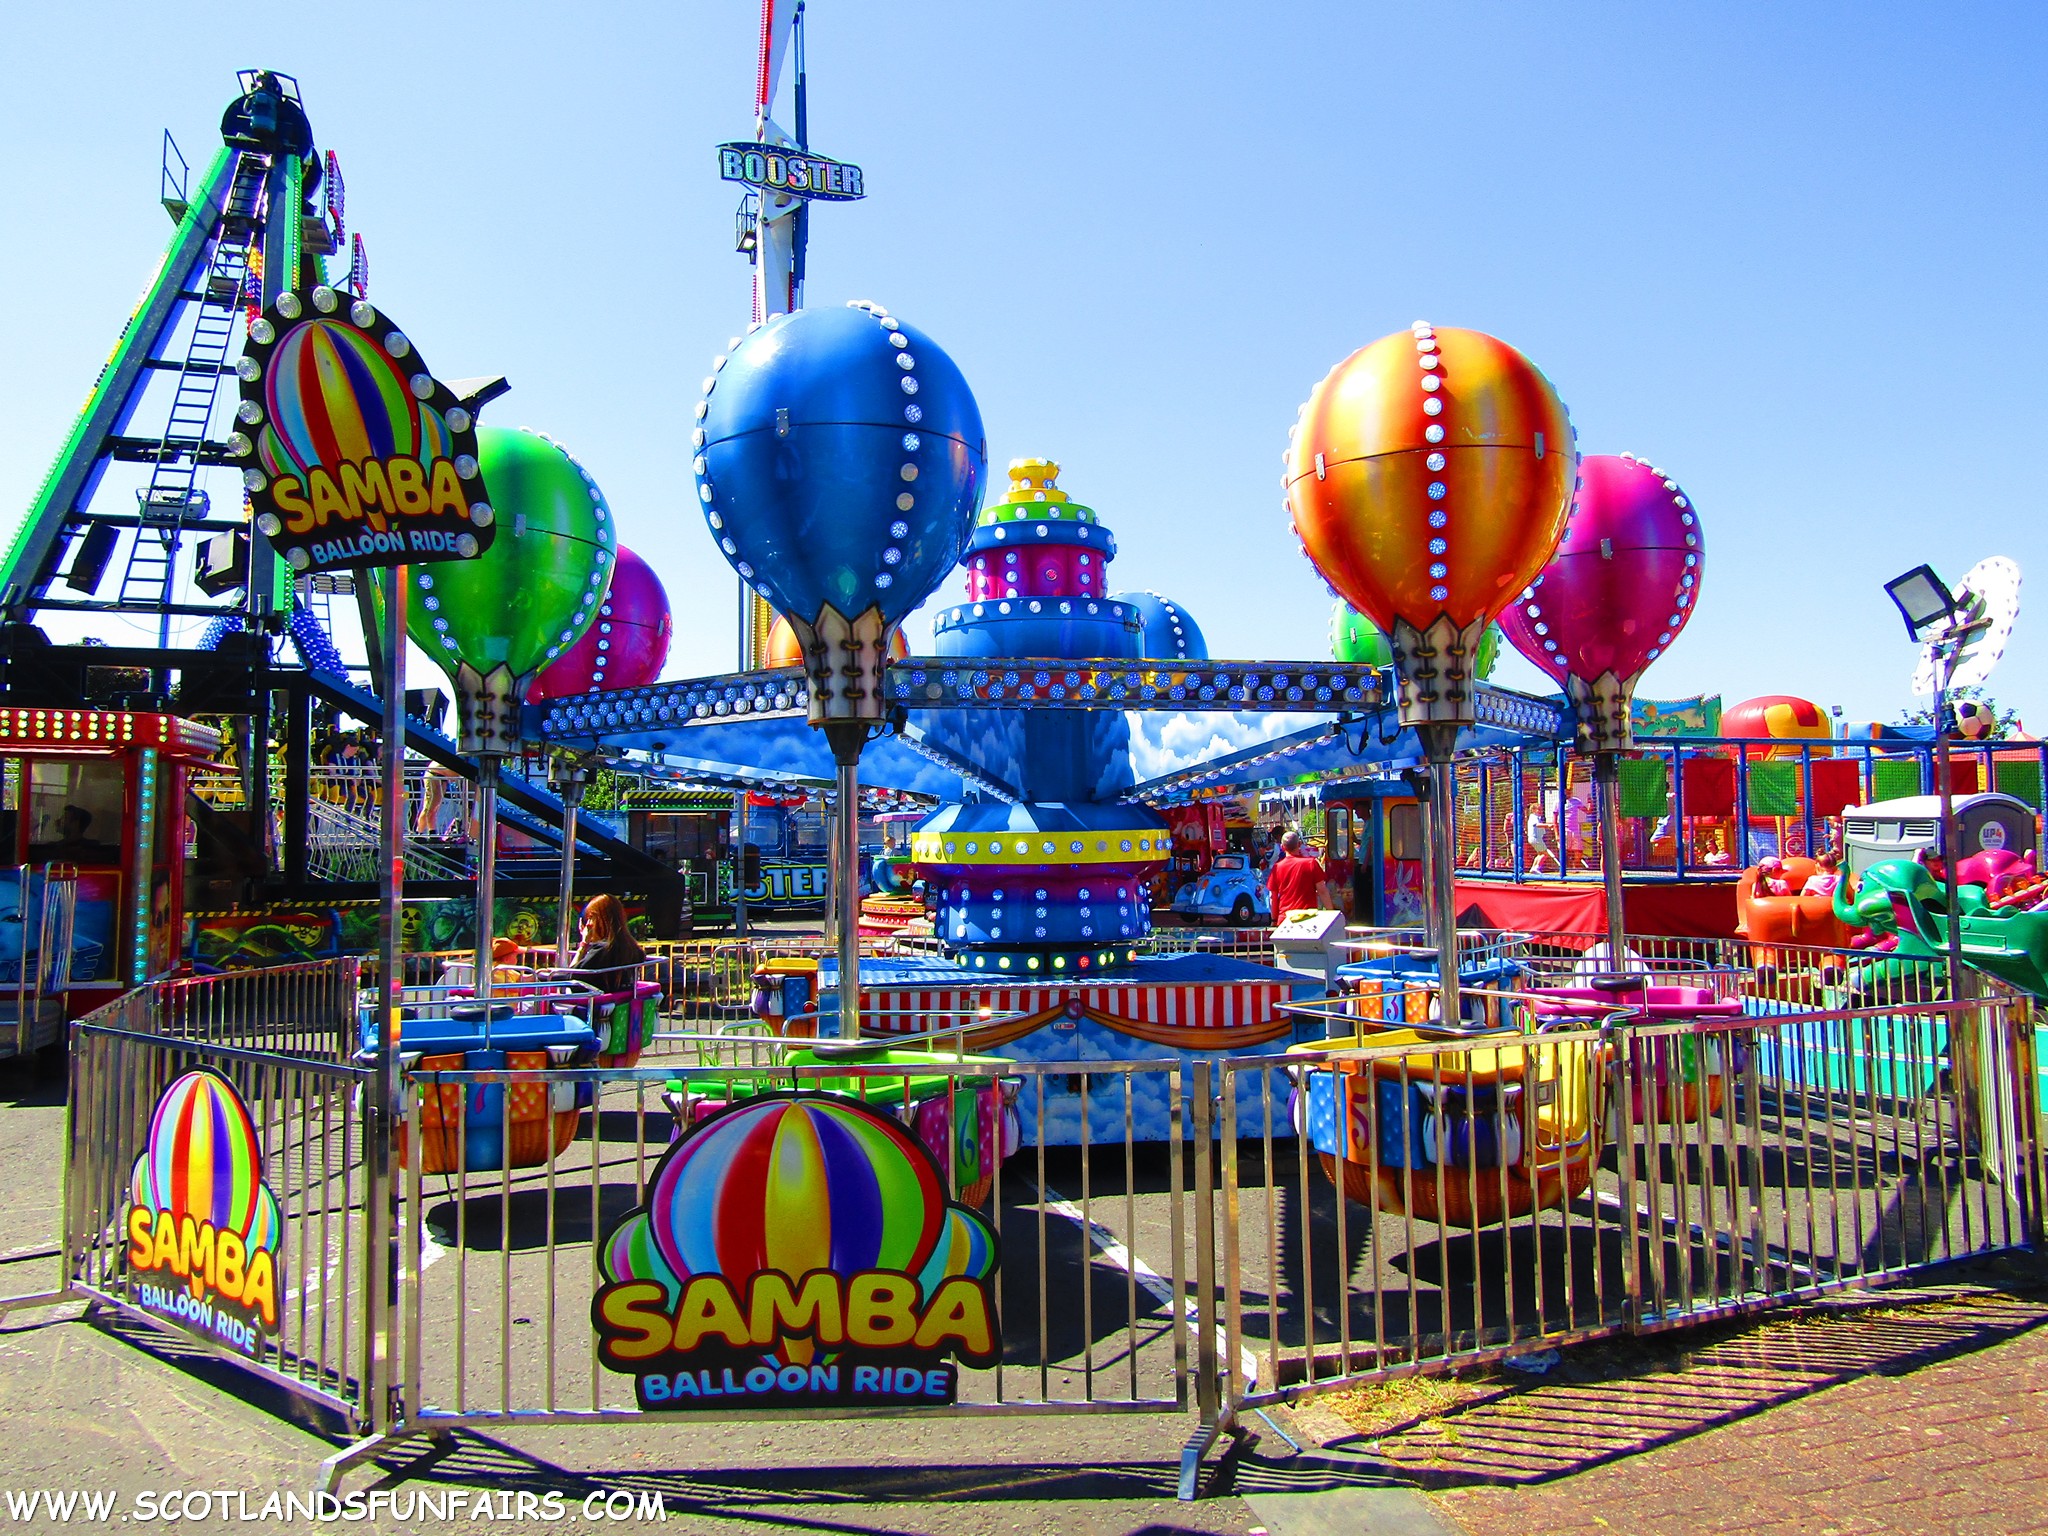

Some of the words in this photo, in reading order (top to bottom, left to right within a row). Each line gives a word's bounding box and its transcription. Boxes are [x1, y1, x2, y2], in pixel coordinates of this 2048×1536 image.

[721, 150, 863, 195] BOOSTER
[272, 456, 470, 534] SAMBA
[311, 531, 404, 564] BALLOON
[409, 530, 458, 553] RIDE
[129, 1207, 276, 1325] SAMBA
[141, 1283, 213, 1328] BALLOON
[217, 1310, 257, 1353] RIDE
[602, 1271, 994, 1359] SAMBA
[643, 1364, 839, 1401] BALLOON
[853, 1366, 951, 1396] RIDE
